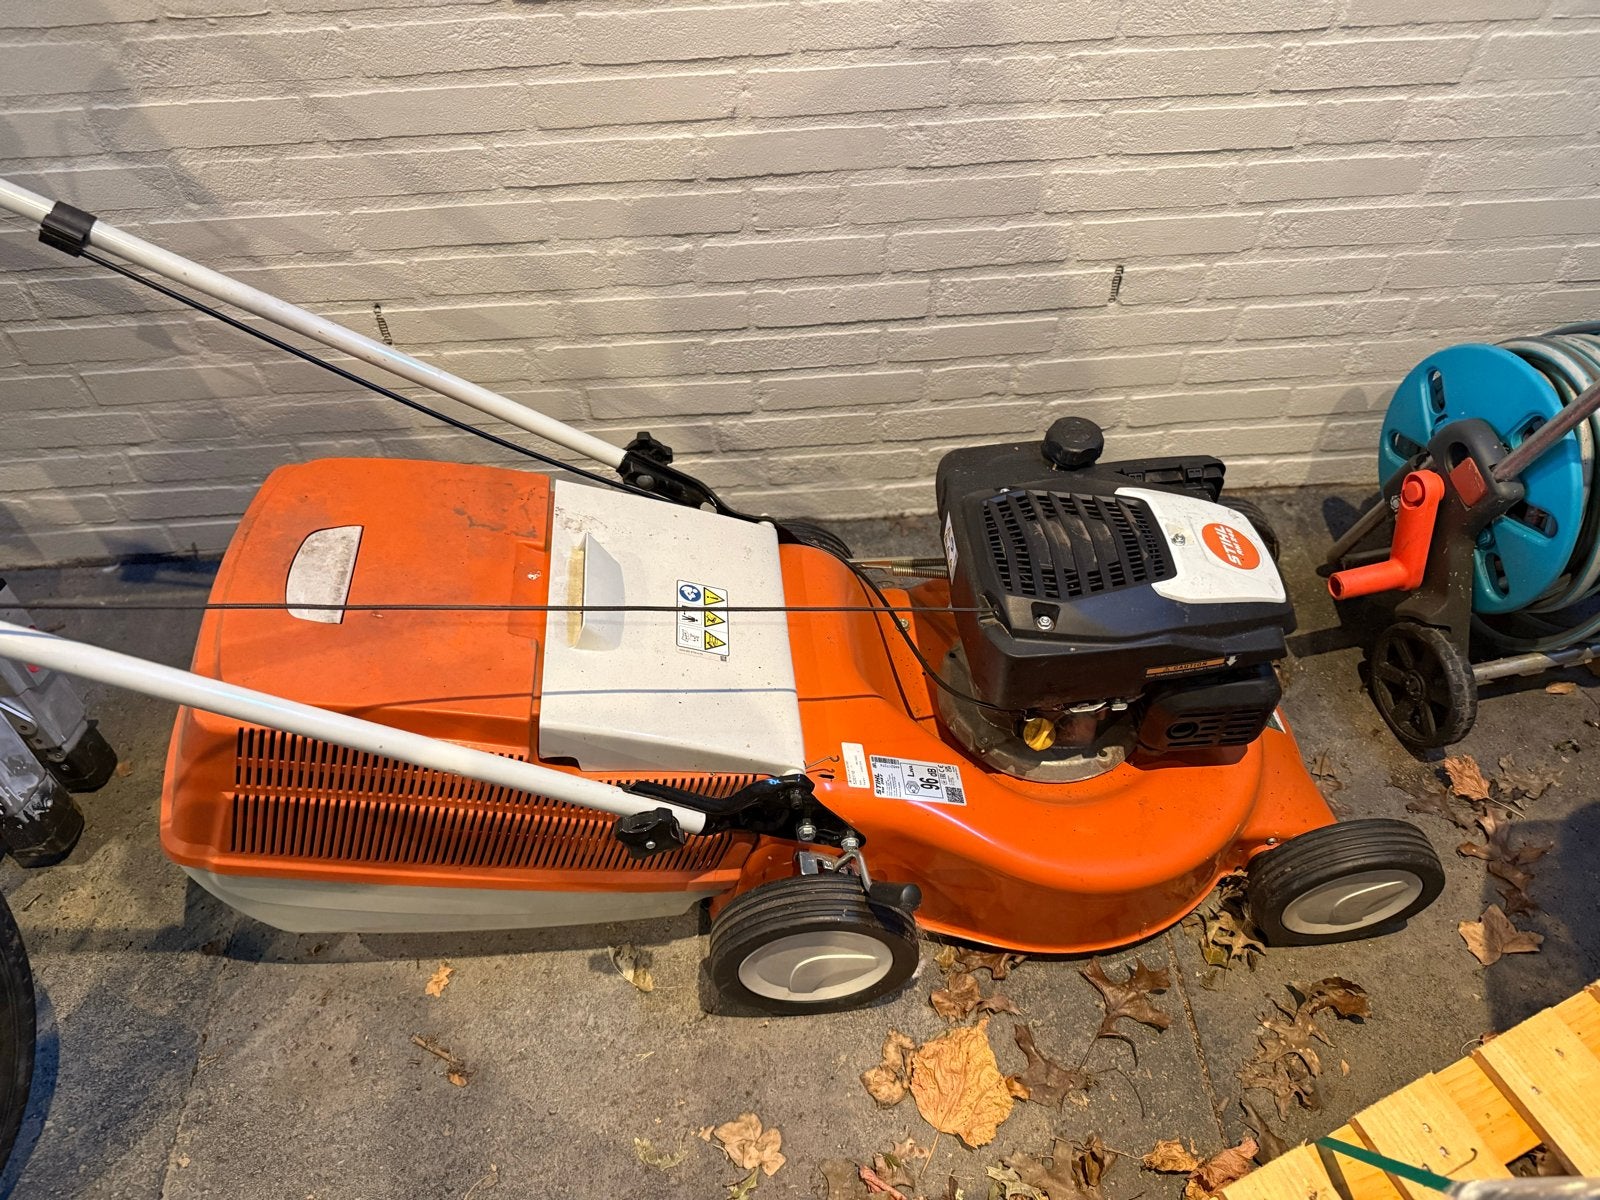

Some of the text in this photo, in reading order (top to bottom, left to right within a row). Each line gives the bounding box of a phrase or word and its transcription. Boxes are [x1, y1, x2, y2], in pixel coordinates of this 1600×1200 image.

[1214, 525, 1242, 567] STIHL
[1172, 661, 1208, 670] CAUTION
[874, 773, 882, 795] STIHL
[919, 767, 940, 790] 96 dB
